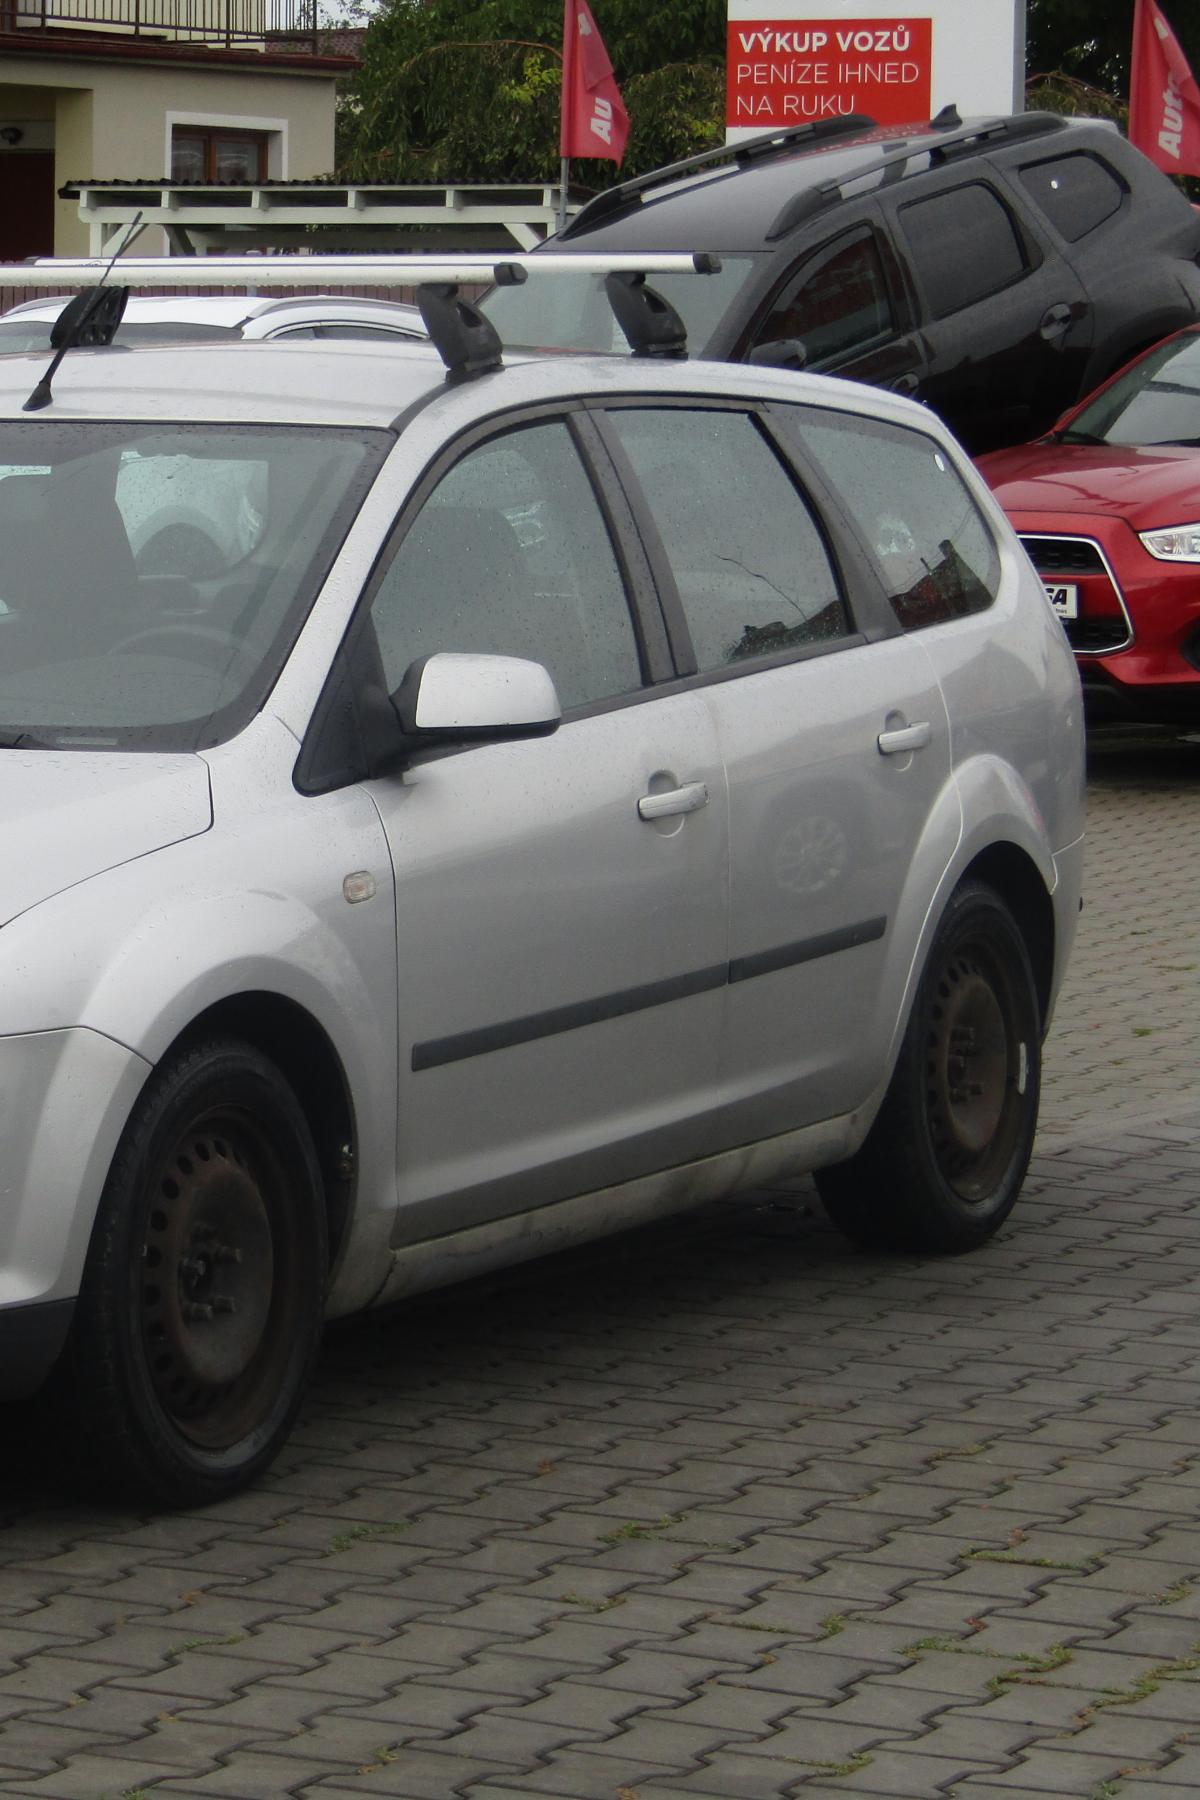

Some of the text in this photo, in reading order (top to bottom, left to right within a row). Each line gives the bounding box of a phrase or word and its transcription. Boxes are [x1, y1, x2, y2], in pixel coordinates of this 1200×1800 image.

[738, 24, 910, 53] VÝKUP VOZŮ
[736, 59, 920, 85] PENÍZE IHNED
[736, 95, 855, 116] NA RUKU
